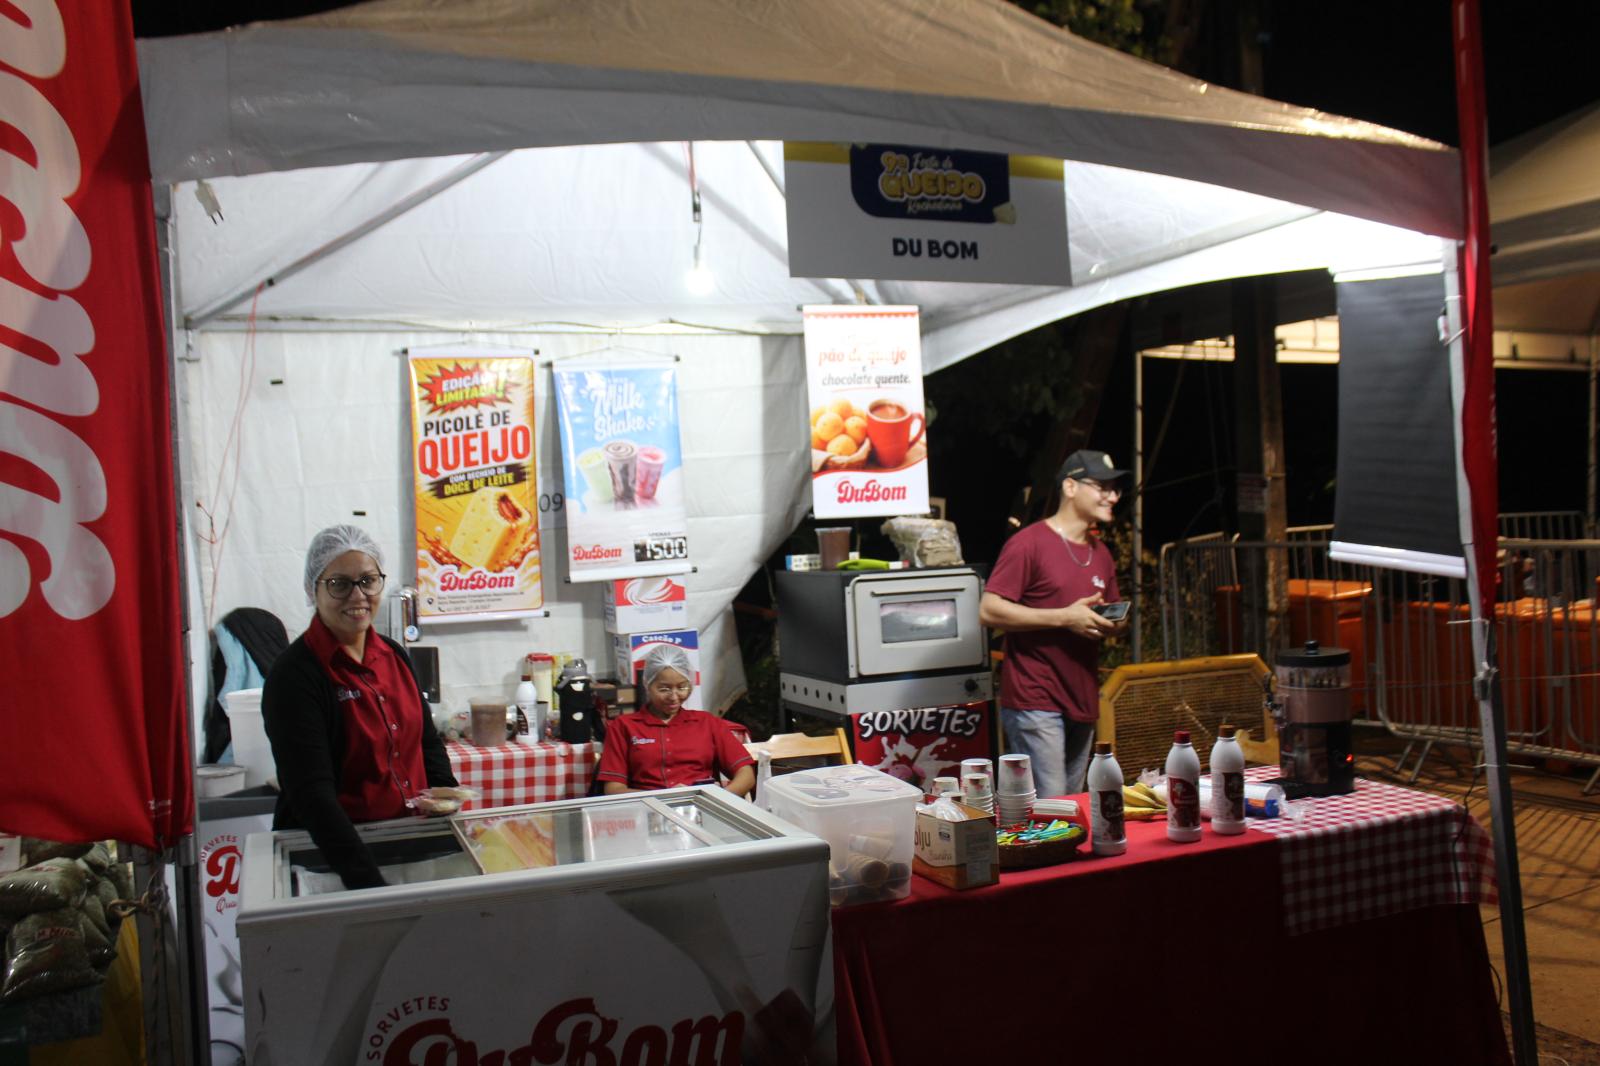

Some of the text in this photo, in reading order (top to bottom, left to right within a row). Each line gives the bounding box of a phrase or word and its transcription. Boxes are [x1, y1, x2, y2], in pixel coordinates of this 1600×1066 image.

[880, 170, 985, 203] QUEIJO
[892, 237, 979, 260] DU BOM
[822, 373, 873, 387] chocolate
[590, 381, 644, 418] Milk
[490, 410, 511, 427] DE
[418, 425, 531, 479] QUEIJO
[444, 472, 514, 496] DOCE DE LEITE
[449, 473, 466, 483] COM
[539, 493, 563, 512] 09
[837, 479, 907, 503] DuBom
[573, 544, 622, 561] DuBom
[440, 570, 515, 592] DuBom
[860, 707, 981, 738] SORVETES
[367, 995, 450, 1062] SORVETES
